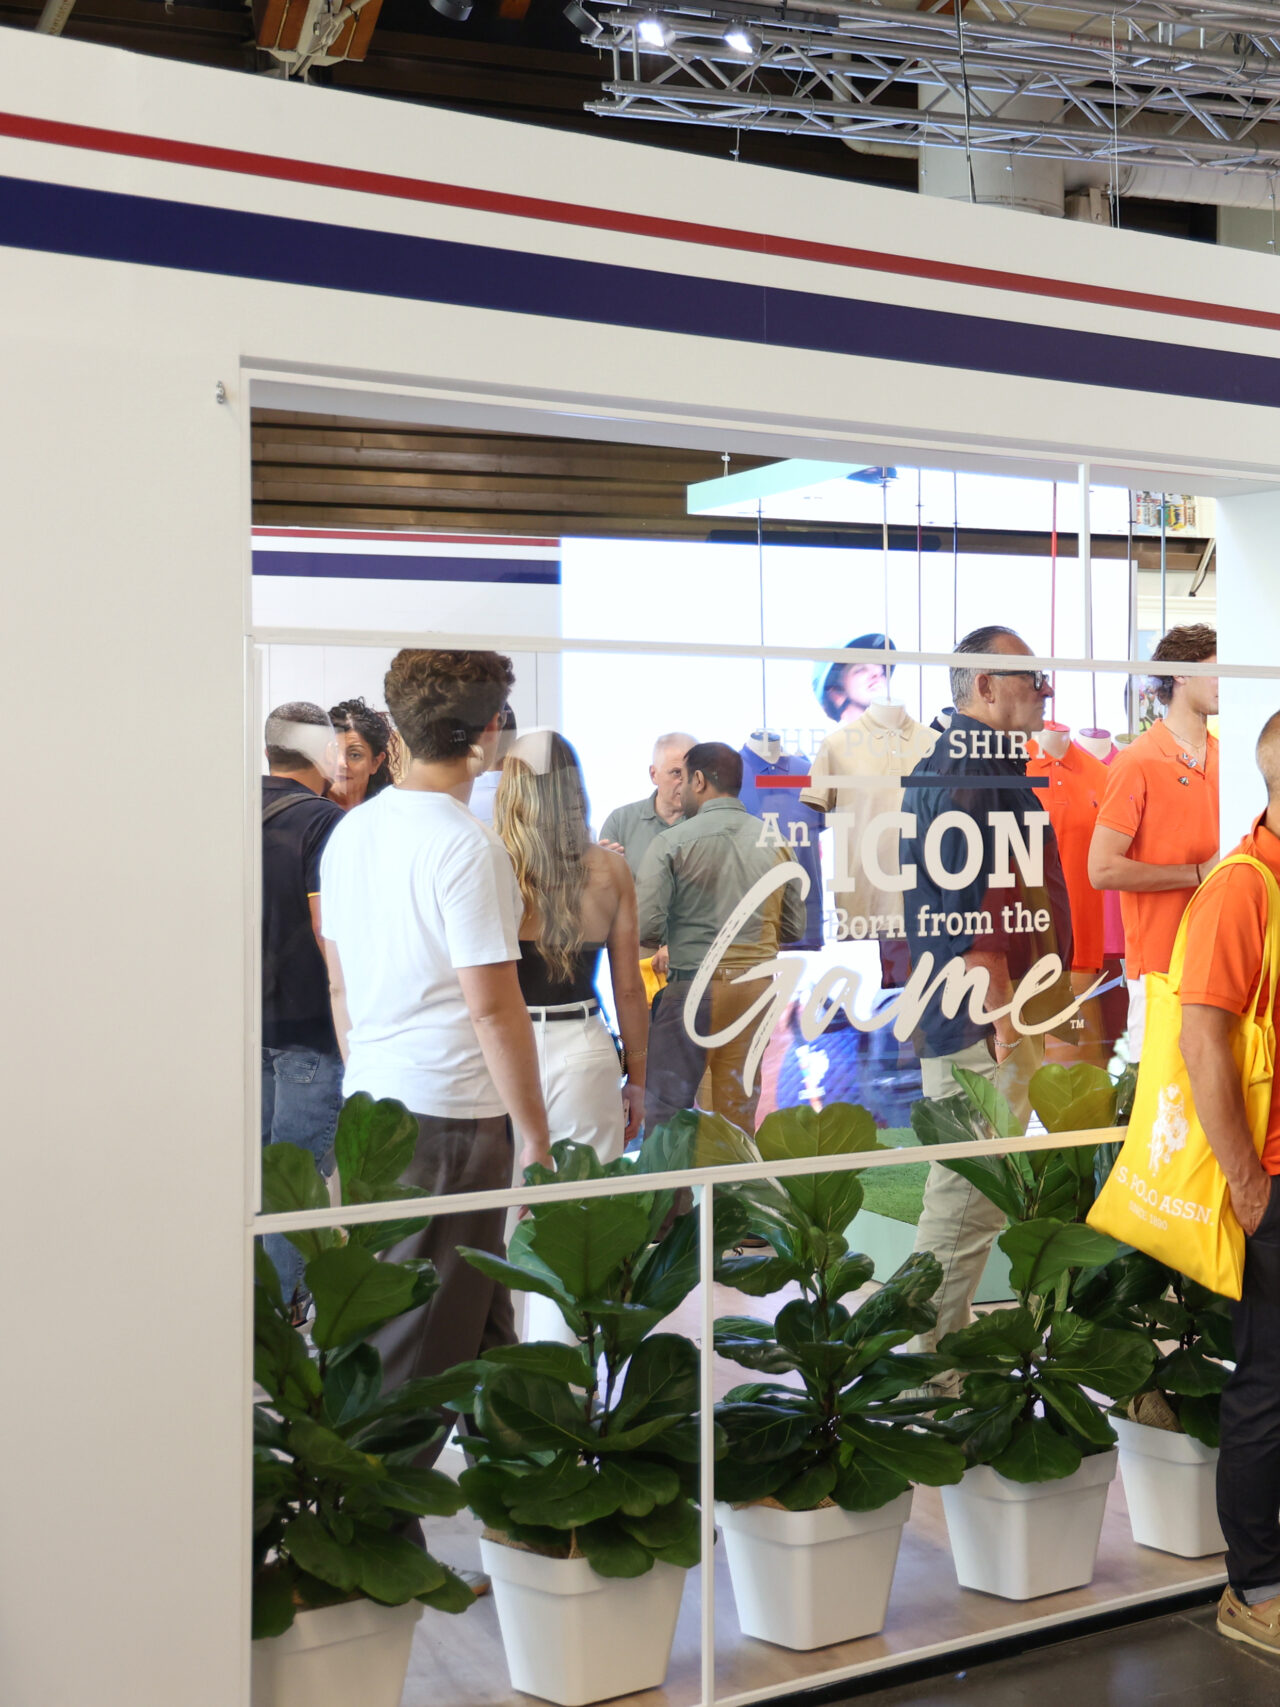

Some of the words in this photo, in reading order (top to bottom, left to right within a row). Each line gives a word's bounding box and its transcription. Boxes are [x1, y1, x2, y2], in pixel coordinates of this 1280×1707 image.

[754, 727, 828, 758] THE
[843, 728, 936, 759] POLO
[948, 730, 1047, 760] SHIRT
[755, 811, 811, 848] An
[825, 810, 1050, 893] ICON
[826, 907, 907, 941] Born
[917, 904, 994, 938] from
[1001, 901, 1051, 934] the
[683, 861, 1109, 1098] Game
[1158, 1194, 1215, 1227] ASSN.
